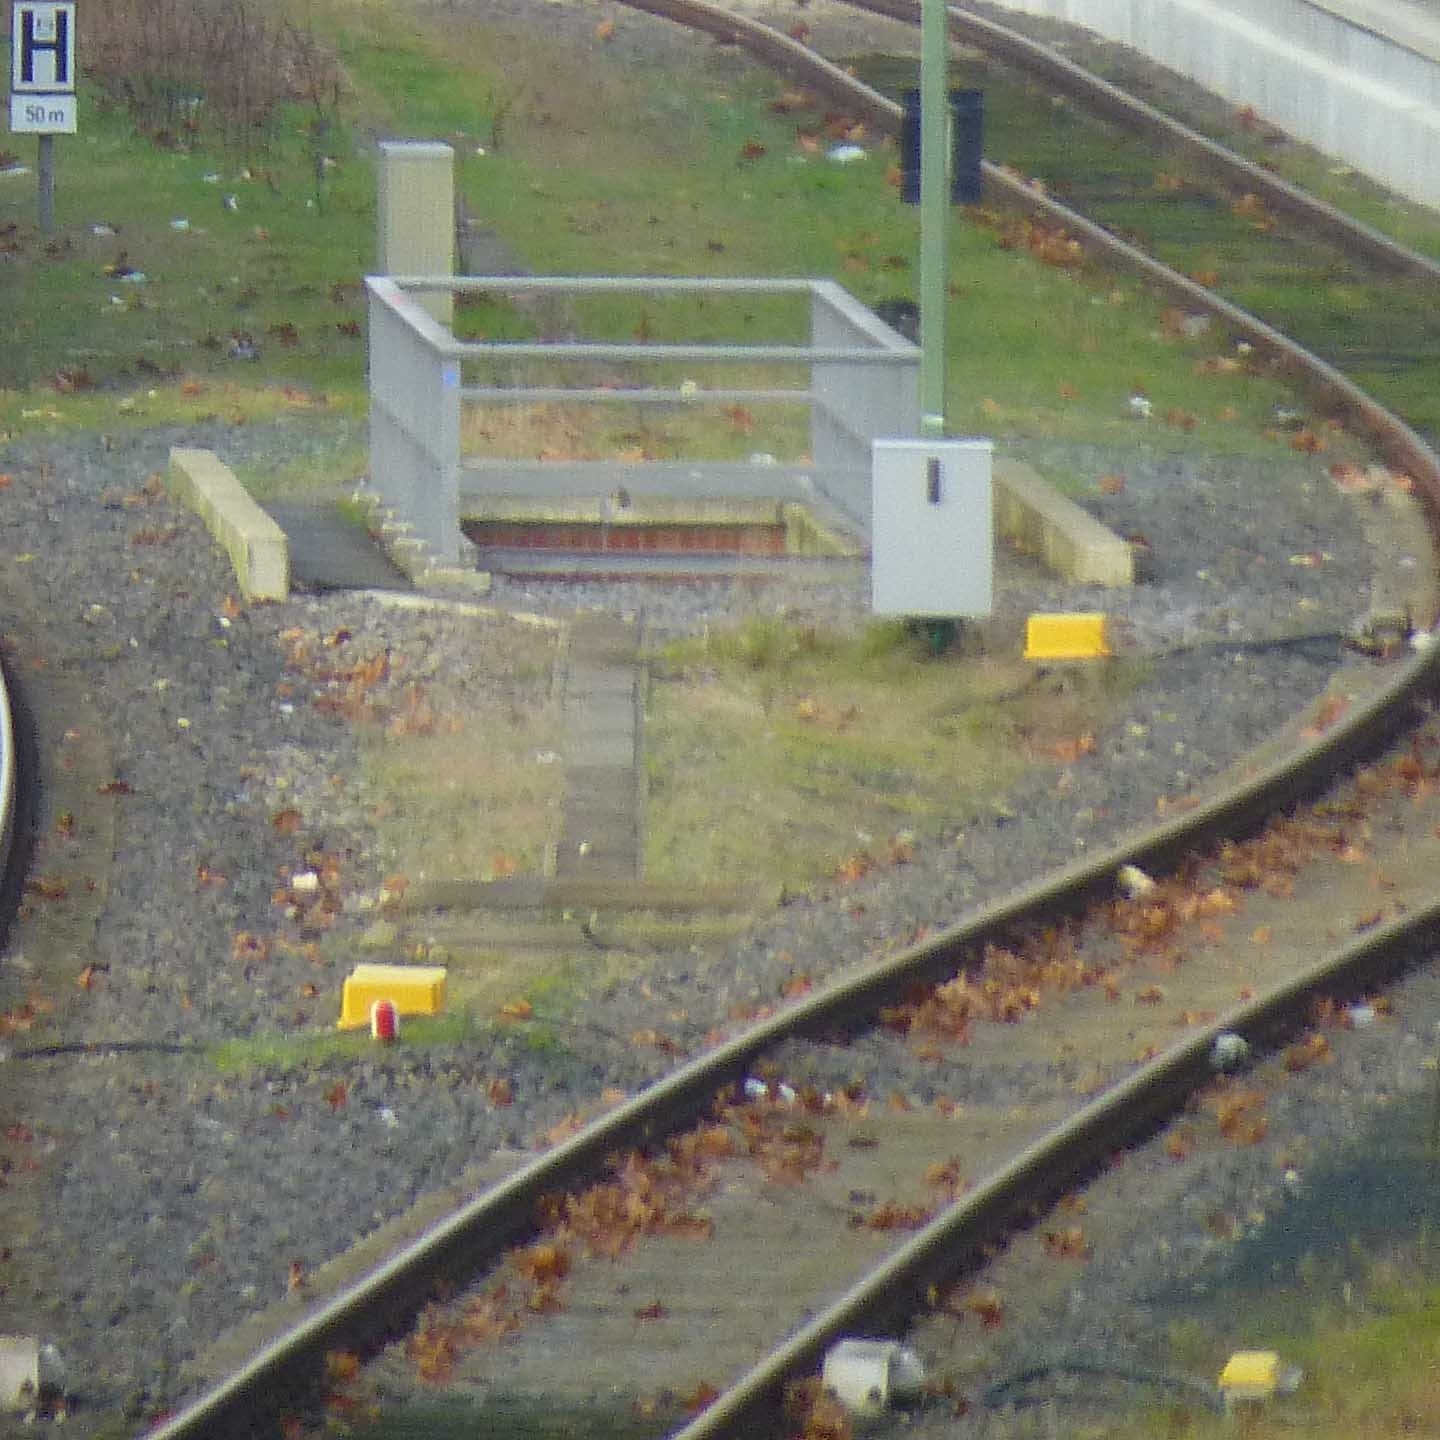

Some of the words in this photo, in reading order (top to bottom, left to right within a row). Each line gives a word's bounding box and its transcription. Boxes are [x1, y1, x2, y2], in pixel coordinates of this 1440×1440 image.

[21, 10, 68, 83] H
[24, 104, 46, 124] 50
[47, 110, 65, 122] m
